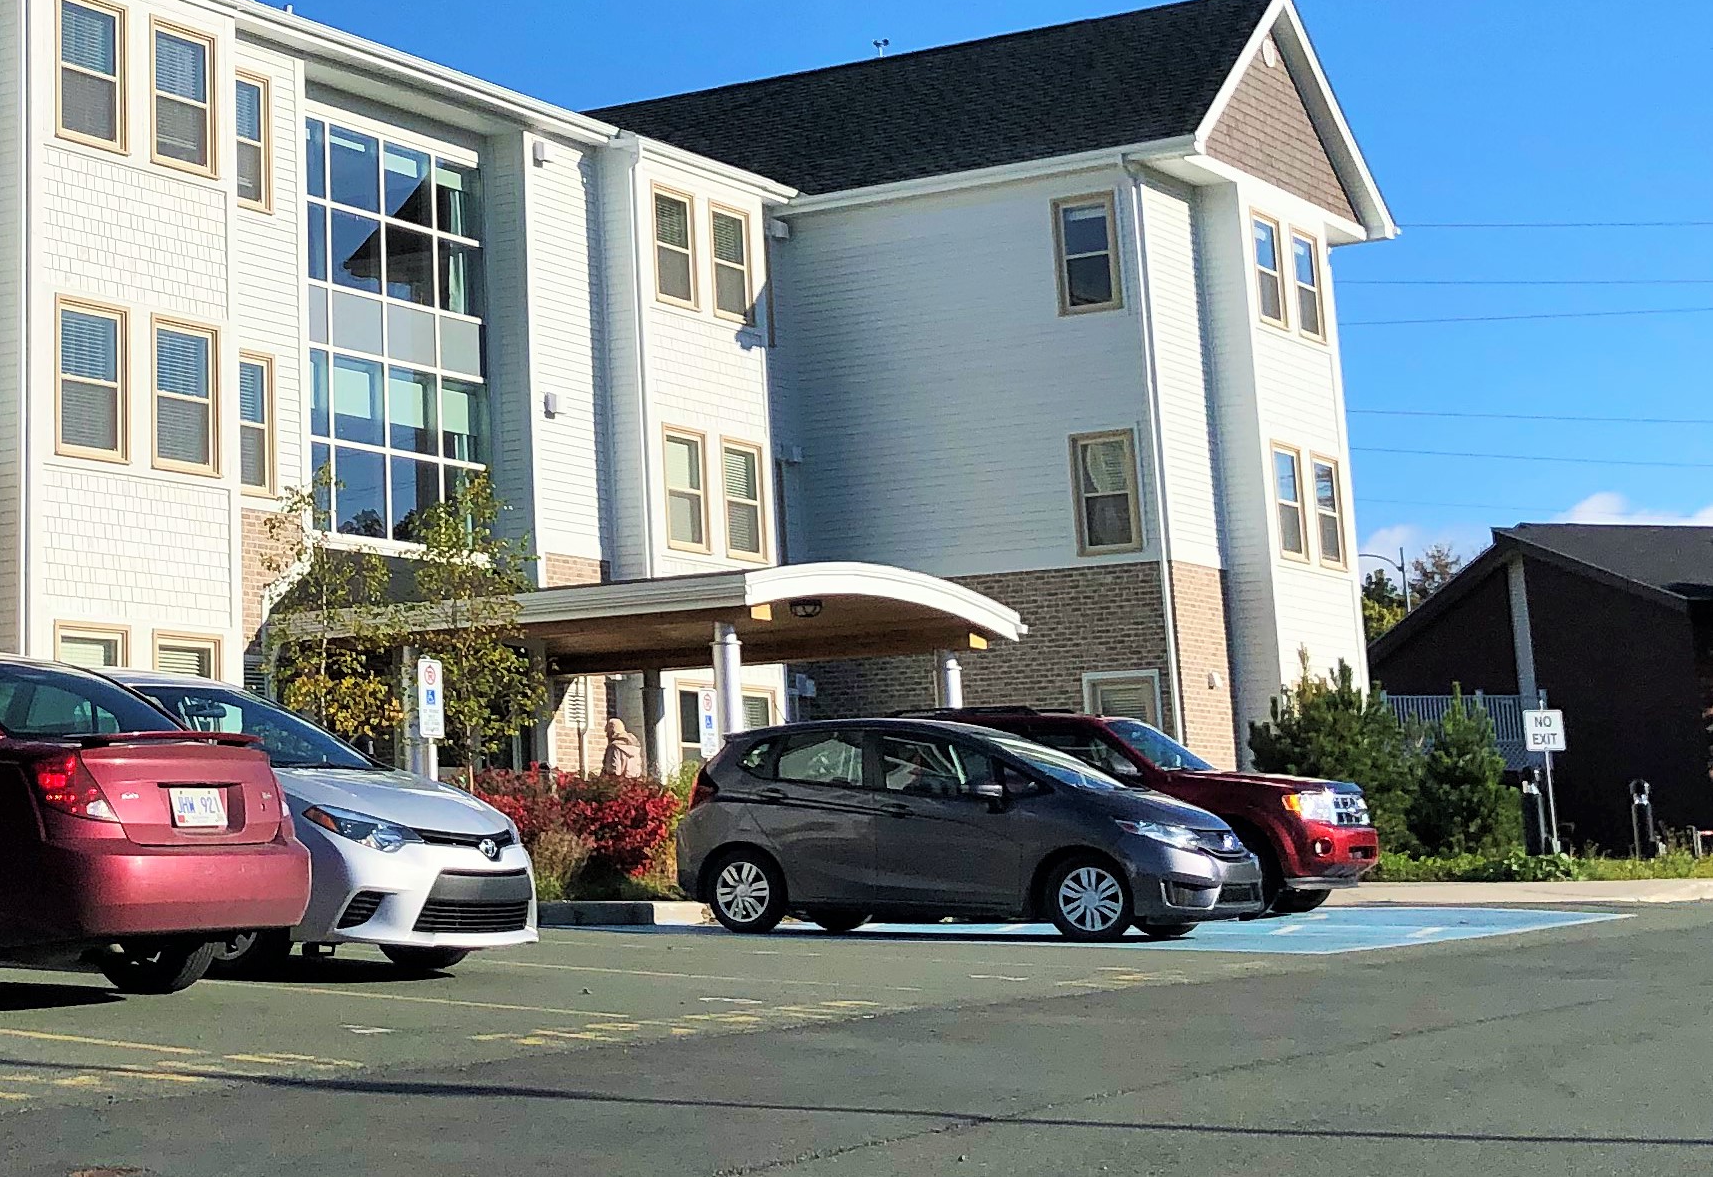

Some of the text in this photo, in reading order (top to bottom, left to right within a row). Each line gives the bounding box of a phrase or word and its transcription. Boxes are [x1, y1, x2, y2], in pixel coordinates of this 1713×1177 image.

[1534, 715, 1552, 728] NO
[1532, 732, 1558, 745] EXIT
[199, 796, 221, 814] 921
